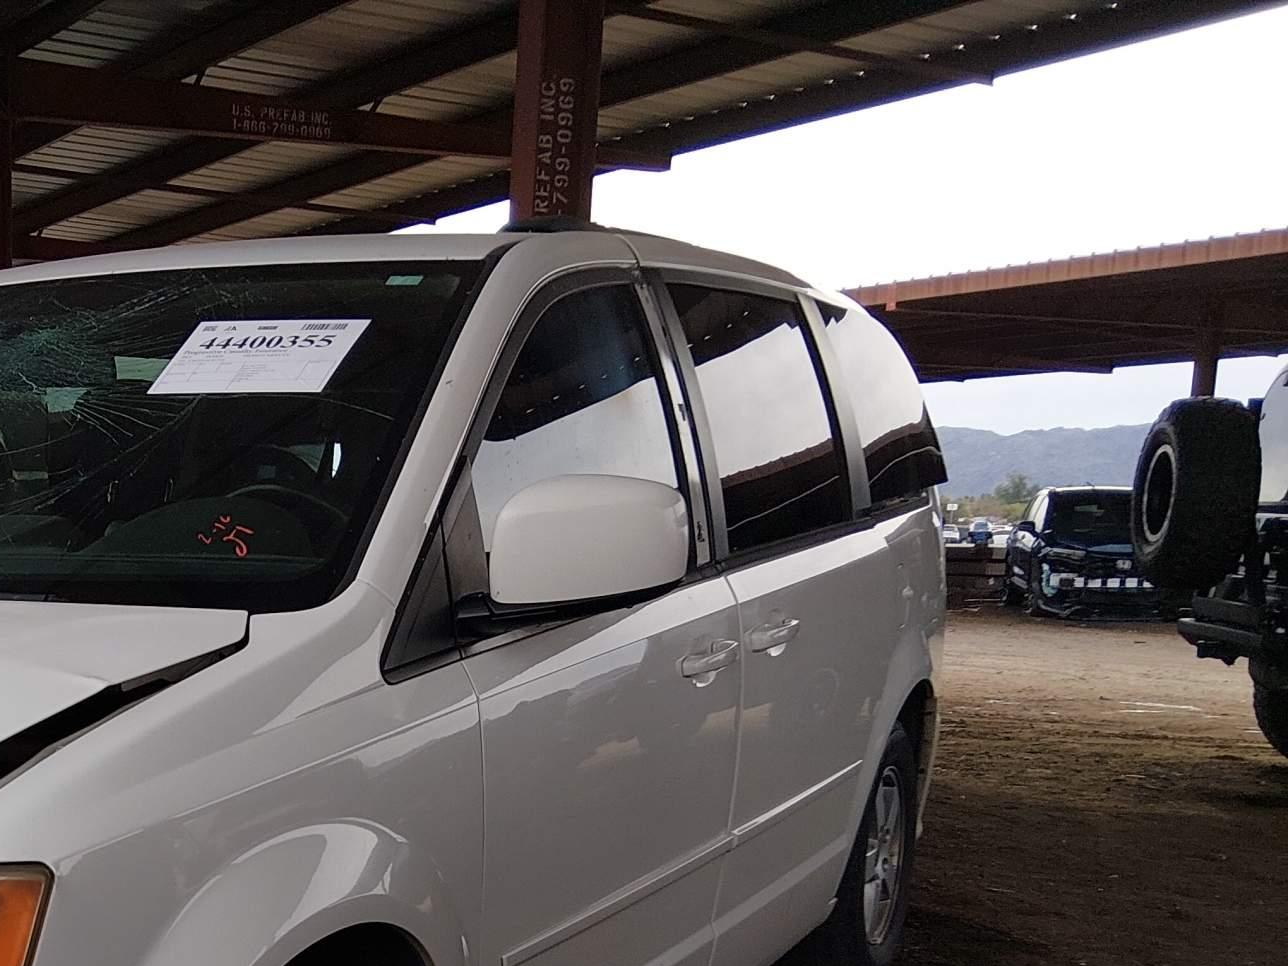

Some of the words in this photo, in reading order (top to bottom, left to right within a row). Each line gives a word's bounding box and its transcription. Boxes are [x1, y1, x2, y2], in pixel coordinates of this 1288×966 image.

[261, 107, 306, 122] PREFAB
[534, 134, 553, 213] REFAB
[199, 334, 337, 350] 44400355
